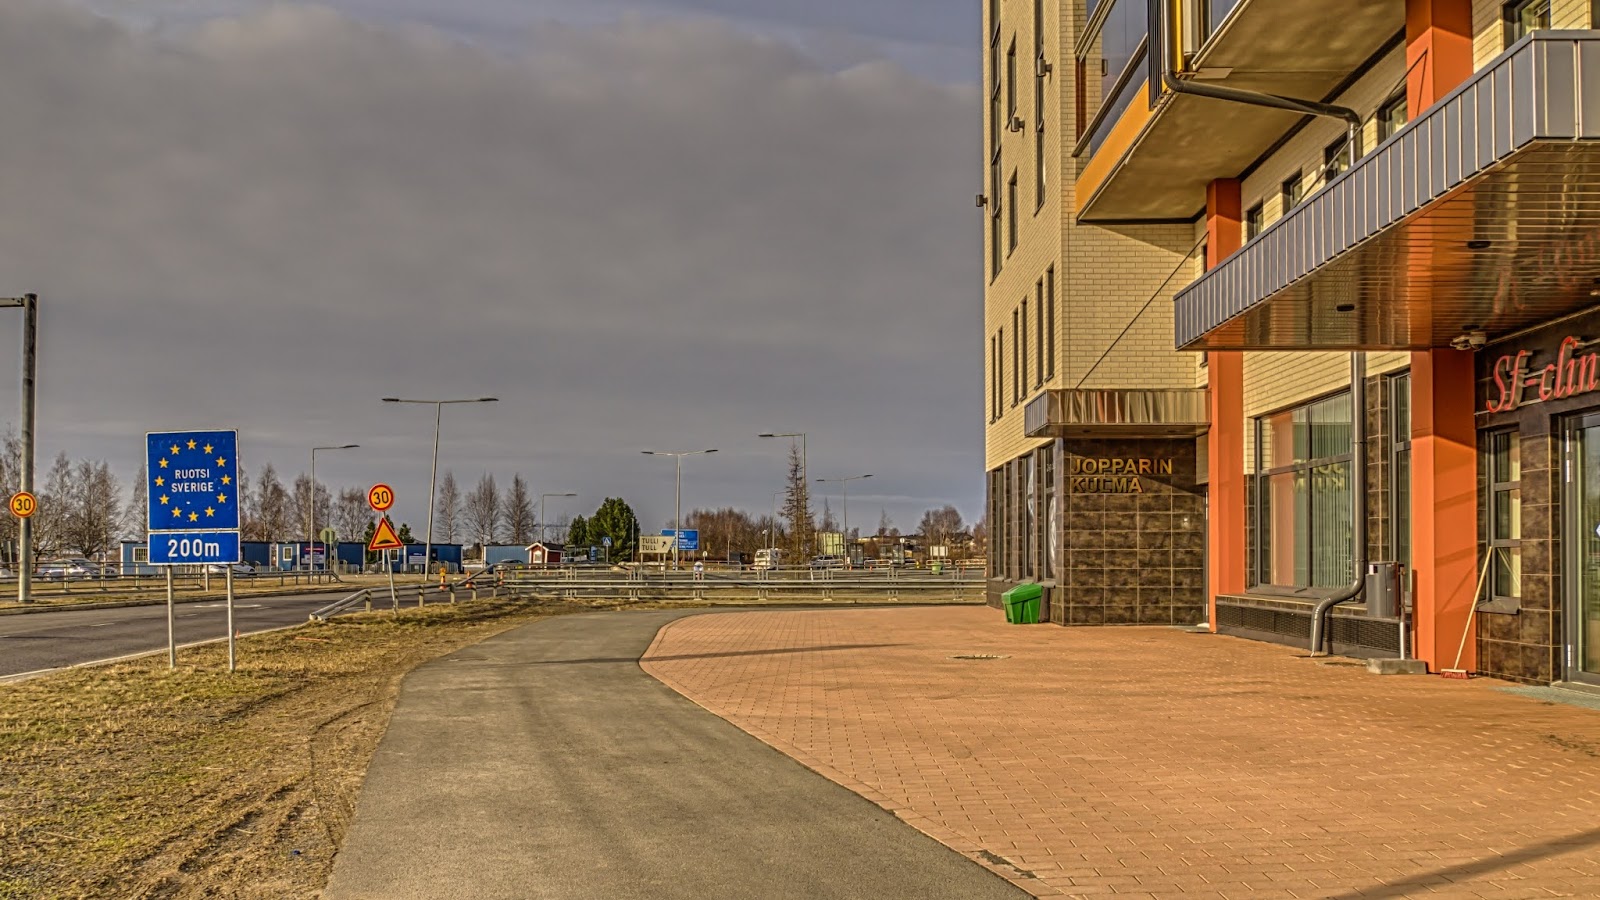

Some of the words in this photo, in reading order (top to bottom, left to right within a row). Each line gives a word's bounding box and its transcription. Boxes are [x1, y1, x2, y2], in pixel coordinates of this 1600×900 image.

[174, 468, 210, 479] RUOTSI
[1071, 458, 1172, 475] JOPPARIN
[171, 482, 214, 493] SVERIGE
[1071, 476, 1143, 493] KULMA
[15, 498, 31, 511] 30
[373, 490, 390, 505] 30
[167, 538, 220, 558] 200m
